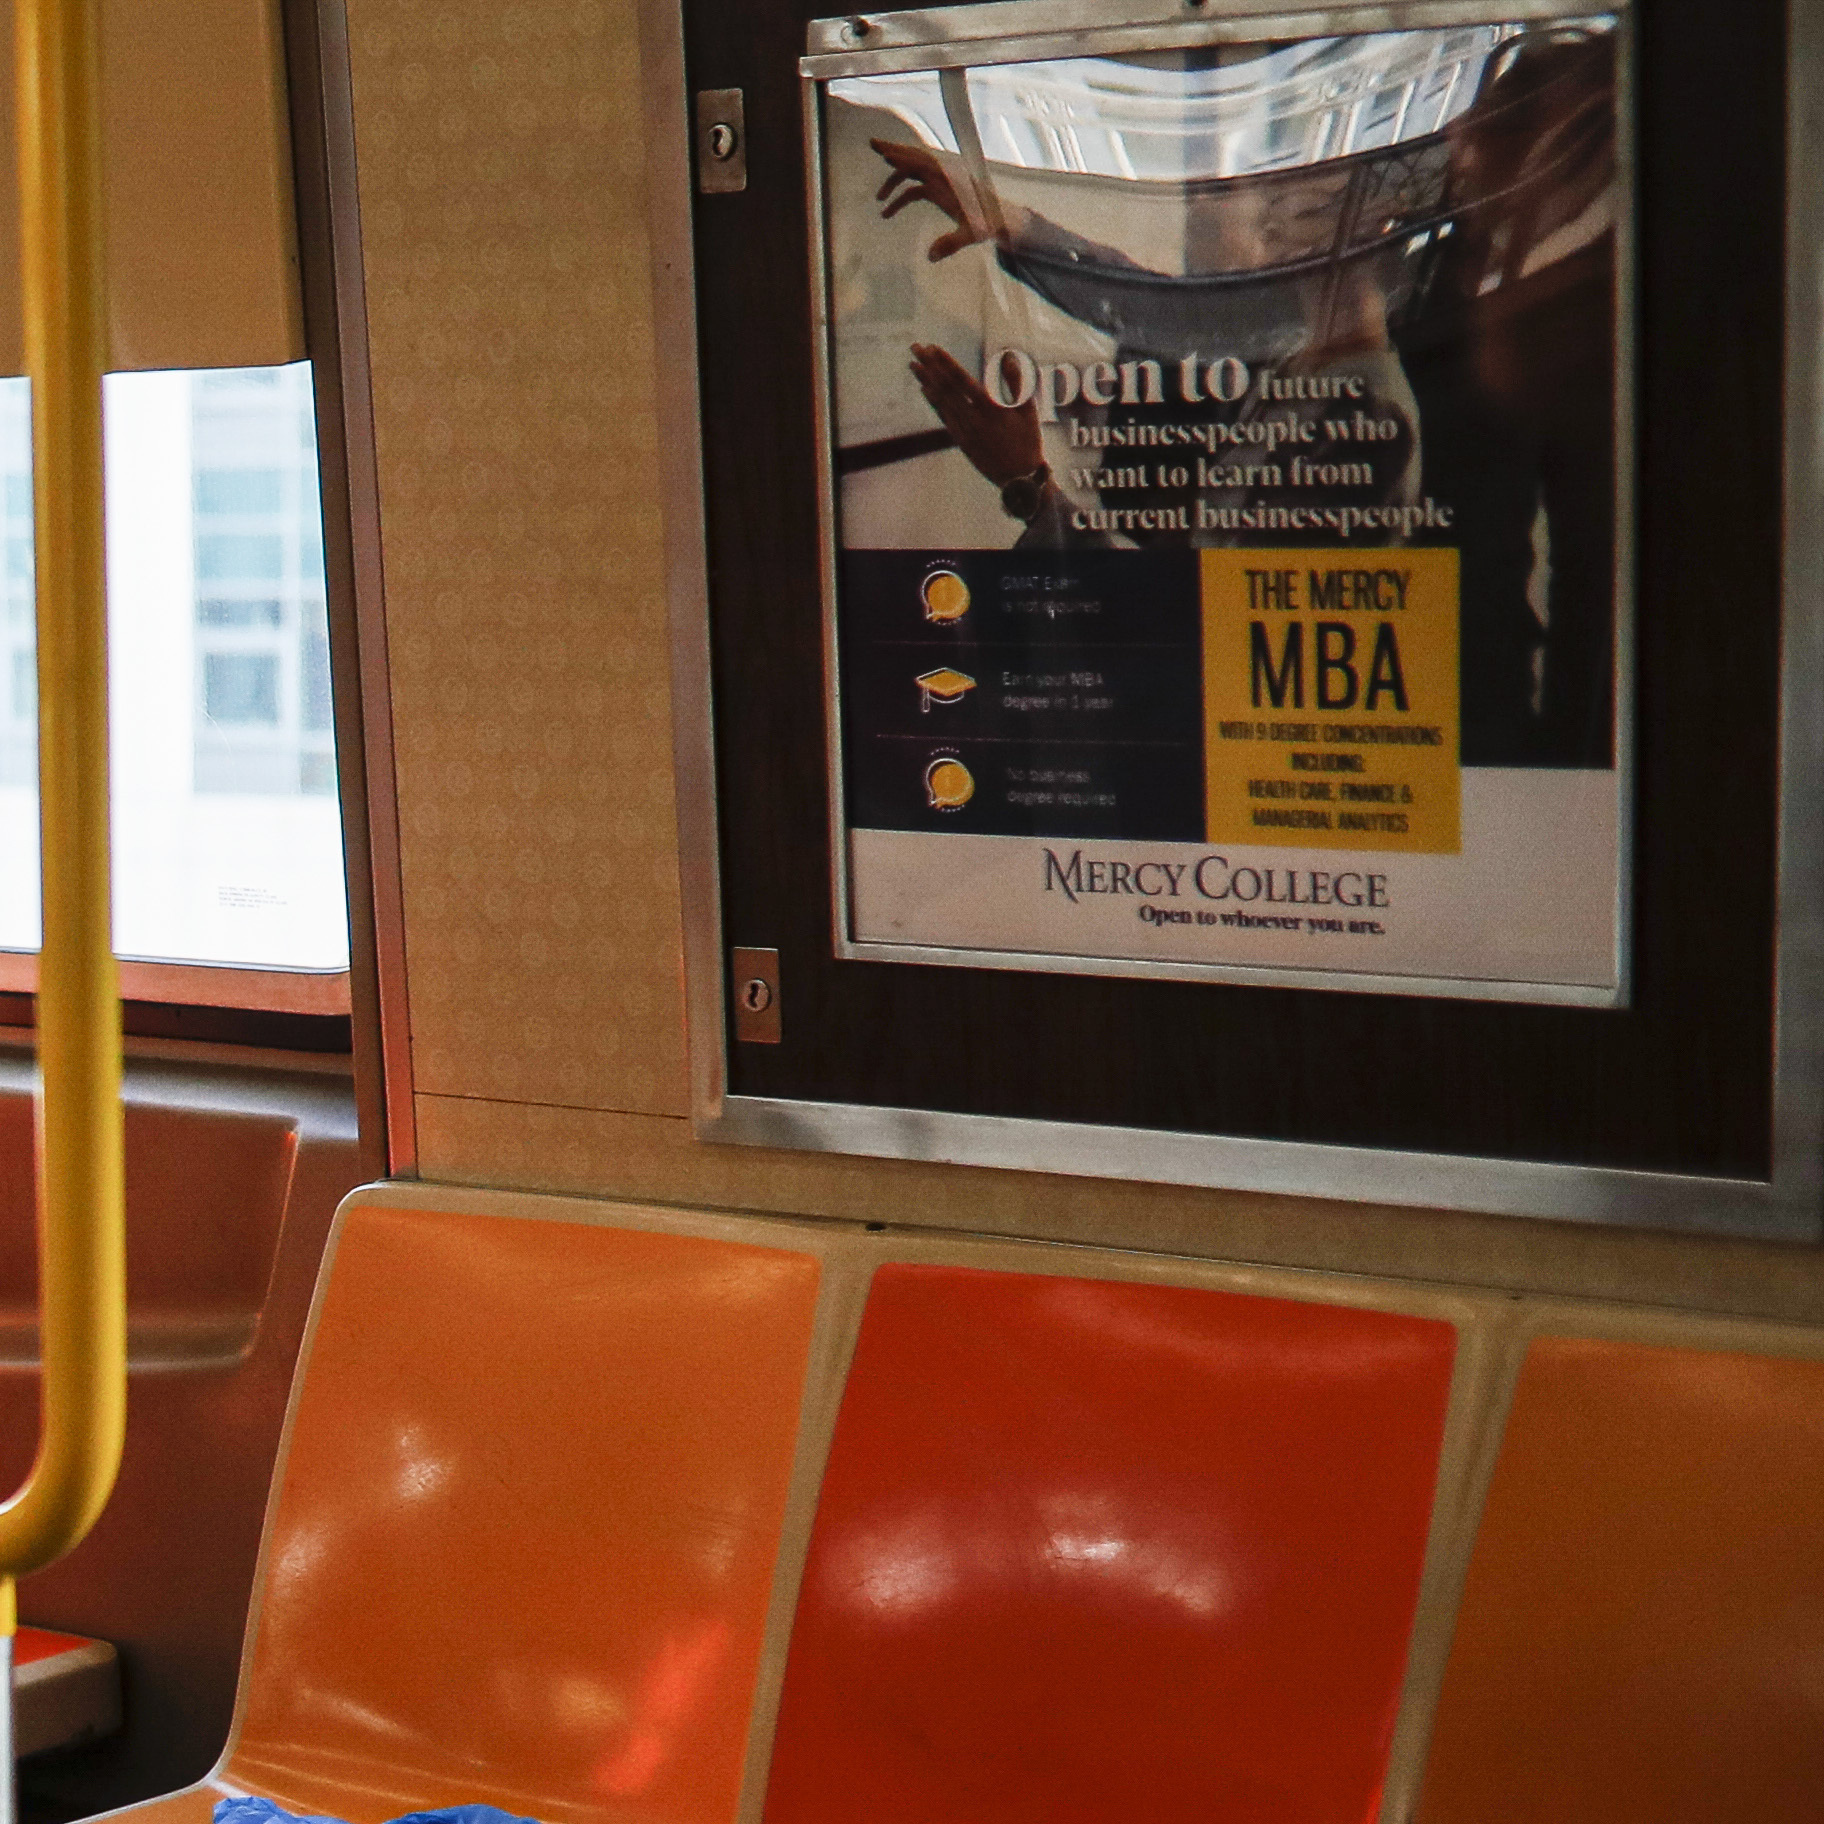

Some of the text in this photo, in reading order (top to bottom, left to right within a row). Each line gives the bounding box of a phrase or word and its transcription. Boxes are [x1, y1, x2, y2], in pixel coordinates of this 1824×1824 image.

[983, 349, 1365, 422] Open to future
[1069, 409, 1398, 453] businesspeople who
[1071, 455, 1373, 488] want to learn from
[1070, 497, 1454, 538] current businesspeople
[1244, 569, 1412, 611] THE MERCY
[1250, 621, 1409, 711] MBA
[1270, 722, 1317, 742] DEGREE
[1248, 779, 1297, 798] HEALTH
[1340, 783, 1395, 803] FINANCE
[1138, 904, 1386, 936] Open to whoever you are.
